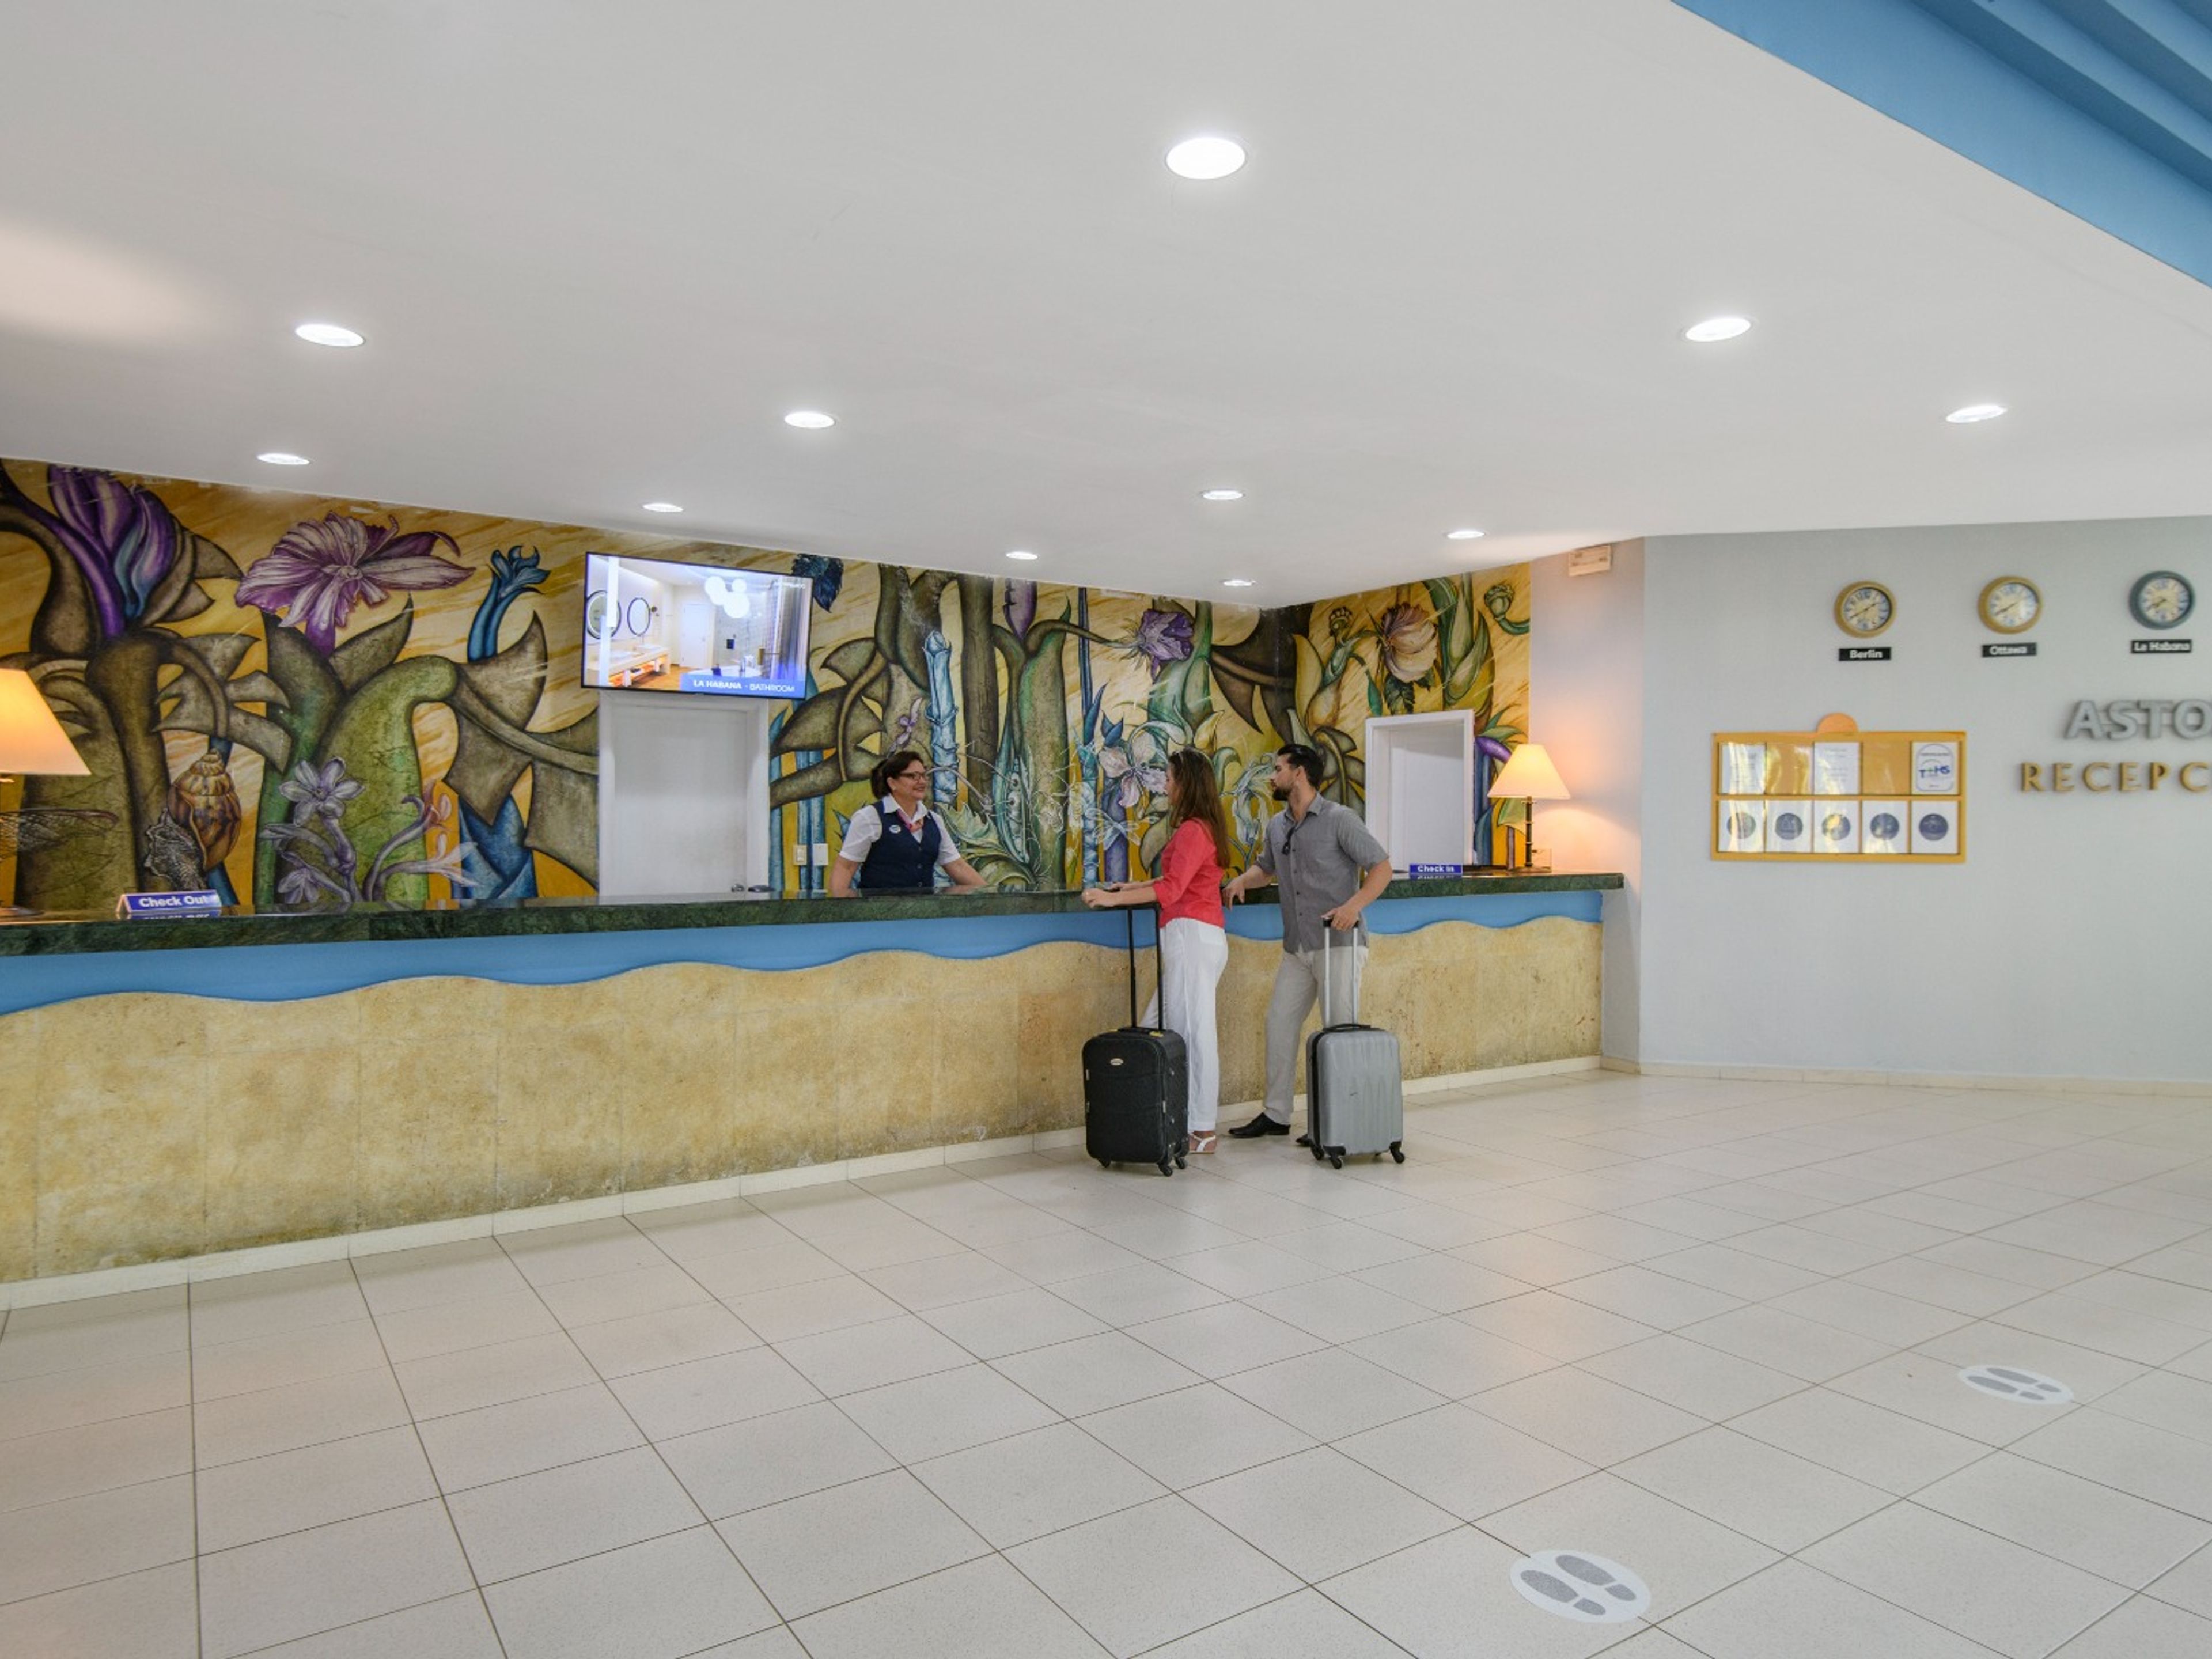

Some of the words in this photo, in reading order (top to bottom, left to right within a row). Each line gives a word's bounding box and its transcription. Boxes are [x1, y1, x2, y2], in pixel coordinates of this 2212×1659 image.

[1989, 646, 2027, 656] Ottawa
[2134, 642, 2147, 652] La
[2149, 641, 2190, 651] Habana
[1849, 649, 1883, 659] Berlin
[2020, 762, 2210, 793] RECEPC
[138, 896, 183, 907] Check
[184, 895, 208, 904] Out
